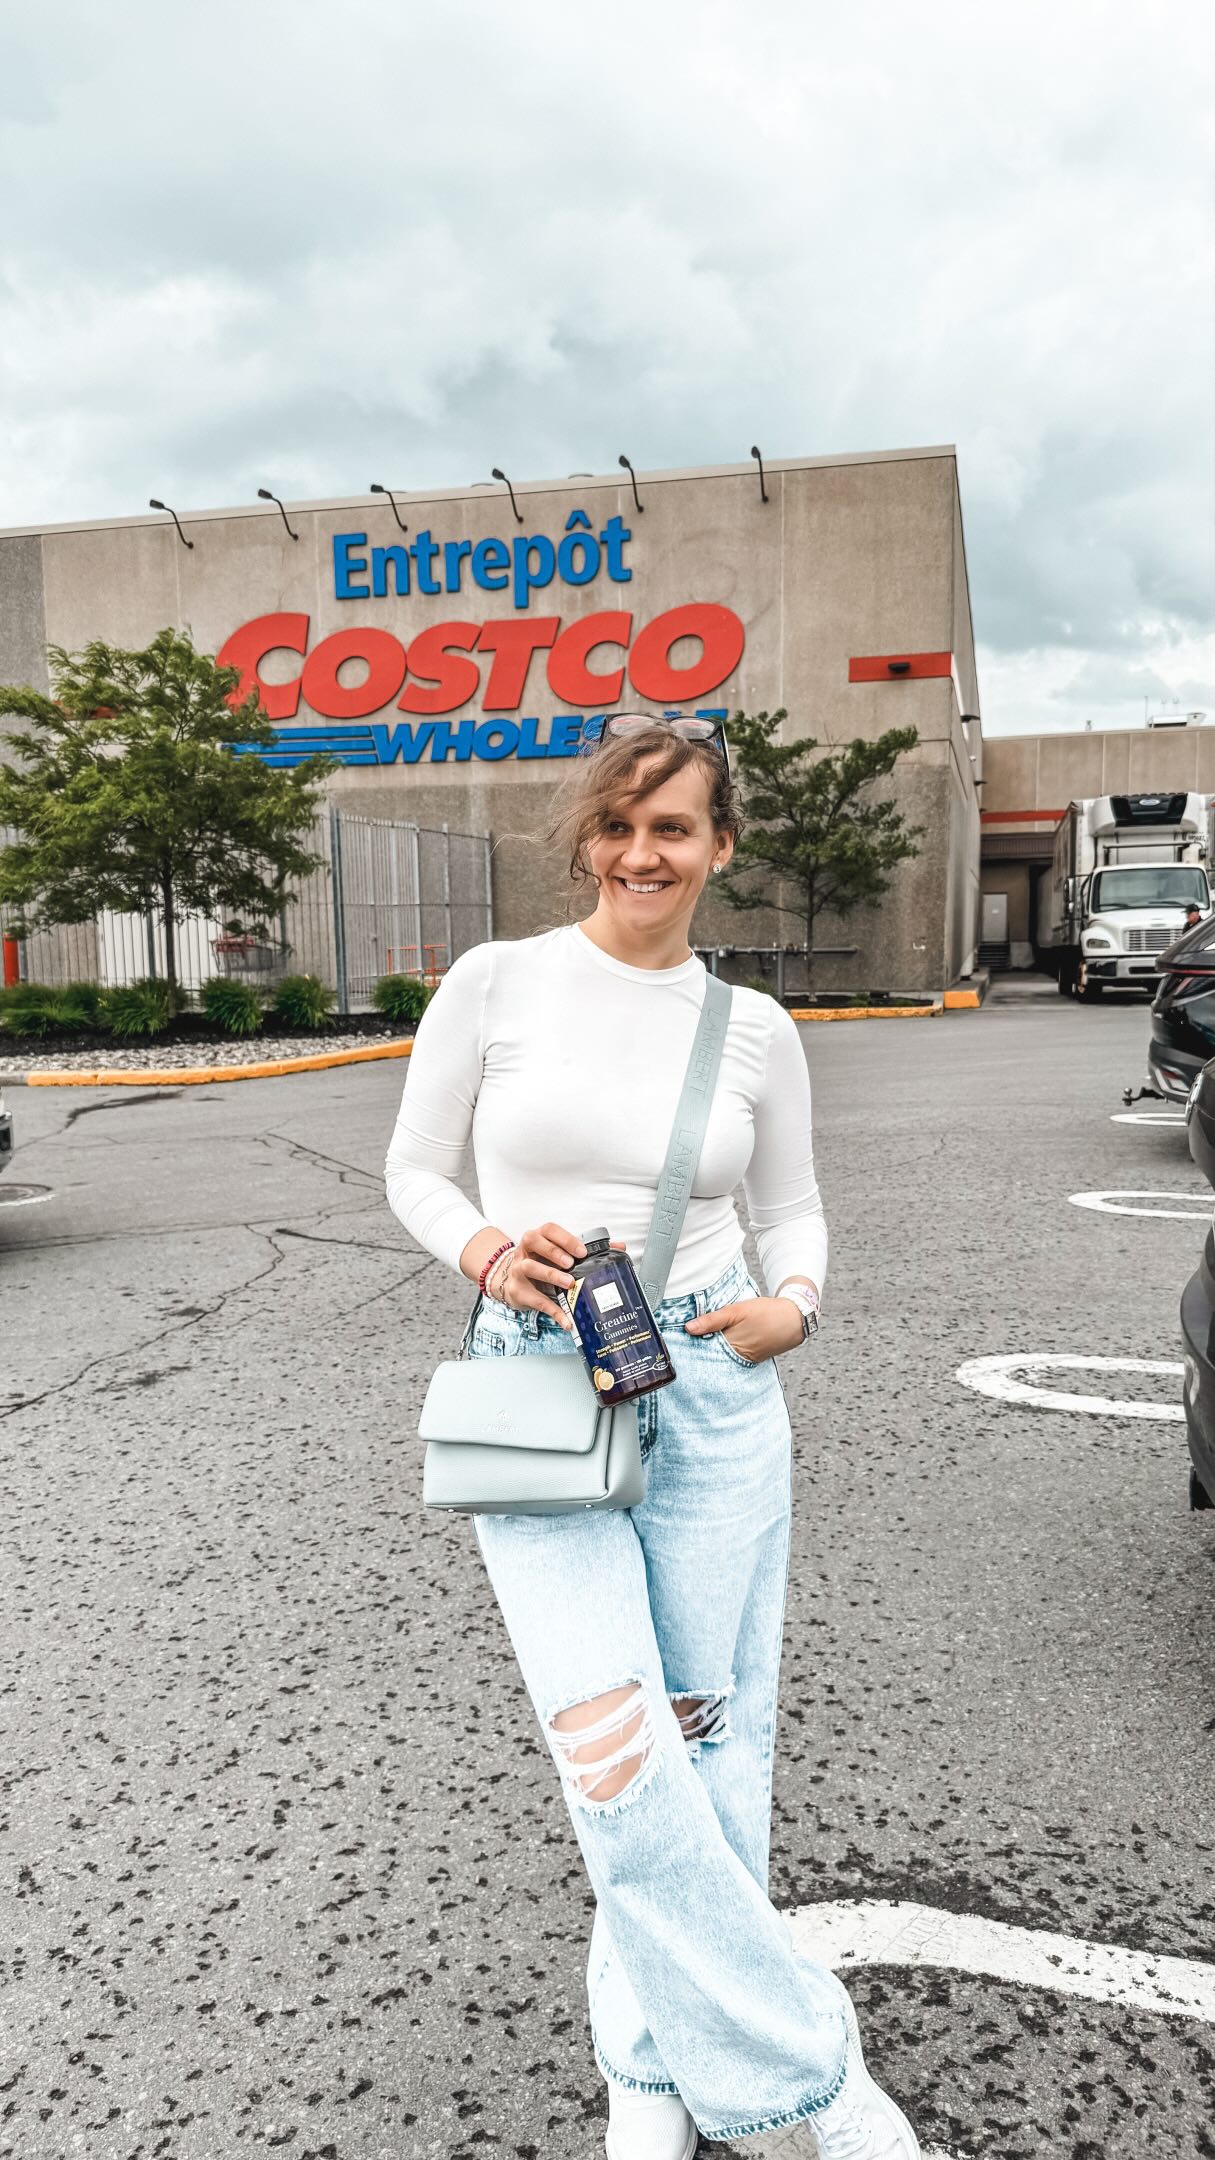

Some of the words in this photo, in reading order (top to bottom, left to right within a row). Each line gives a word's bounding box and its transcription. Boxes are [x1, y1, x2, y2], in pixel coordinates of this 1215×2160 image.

[332, 510, 633, 609] Entrepôt
[216, 602, 745, 720] COSTCO
[690, 1007, 722, 1098] LAMBERT
[655, 1129, 697, 1240] LAMBERT
[594, 1311, 639, 1332] Creatine
